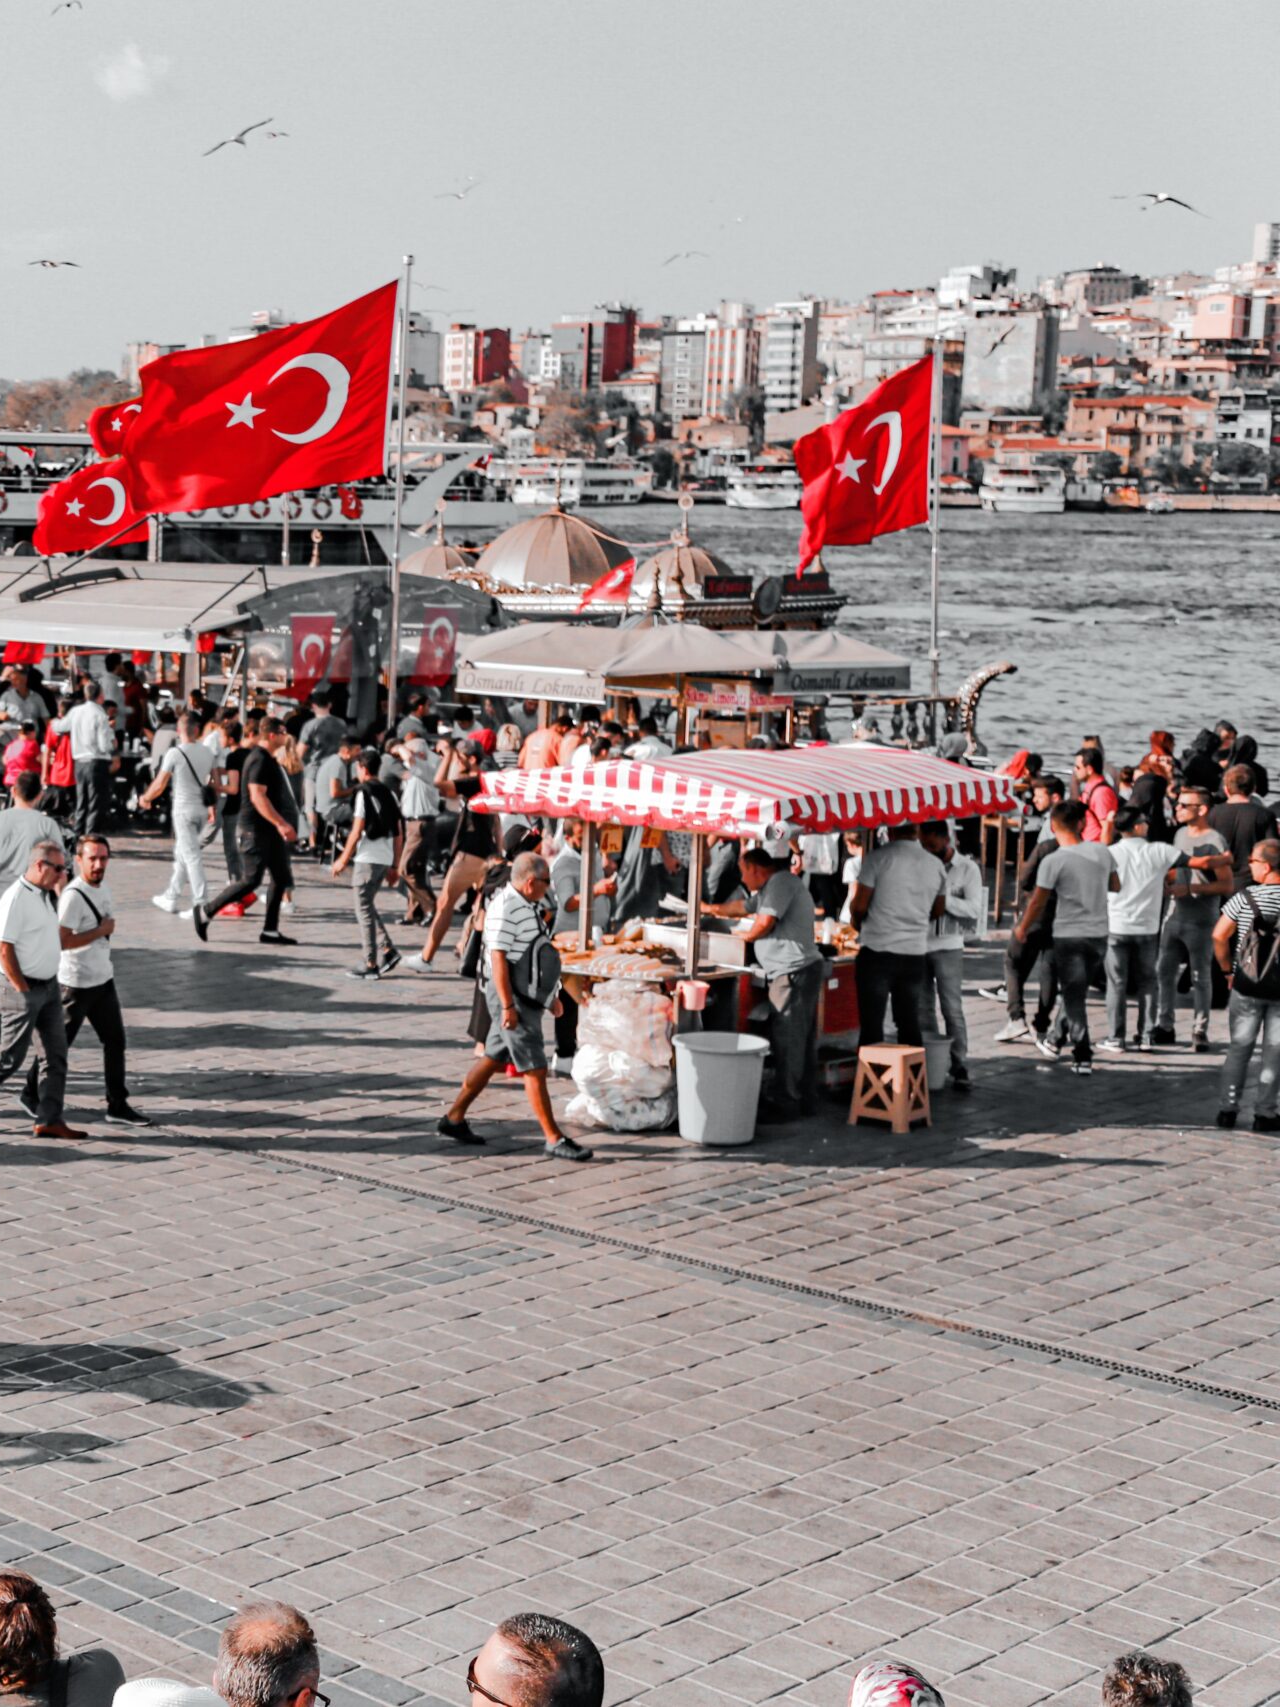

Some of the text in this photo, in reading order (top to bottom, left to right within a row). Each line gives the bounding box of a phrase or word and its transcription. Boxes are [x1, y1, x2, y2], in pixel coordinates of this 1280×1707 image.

[463, 672, 597, 698] Osmanlı Lokması
[791, 670, 841, 691] Osmanlı
